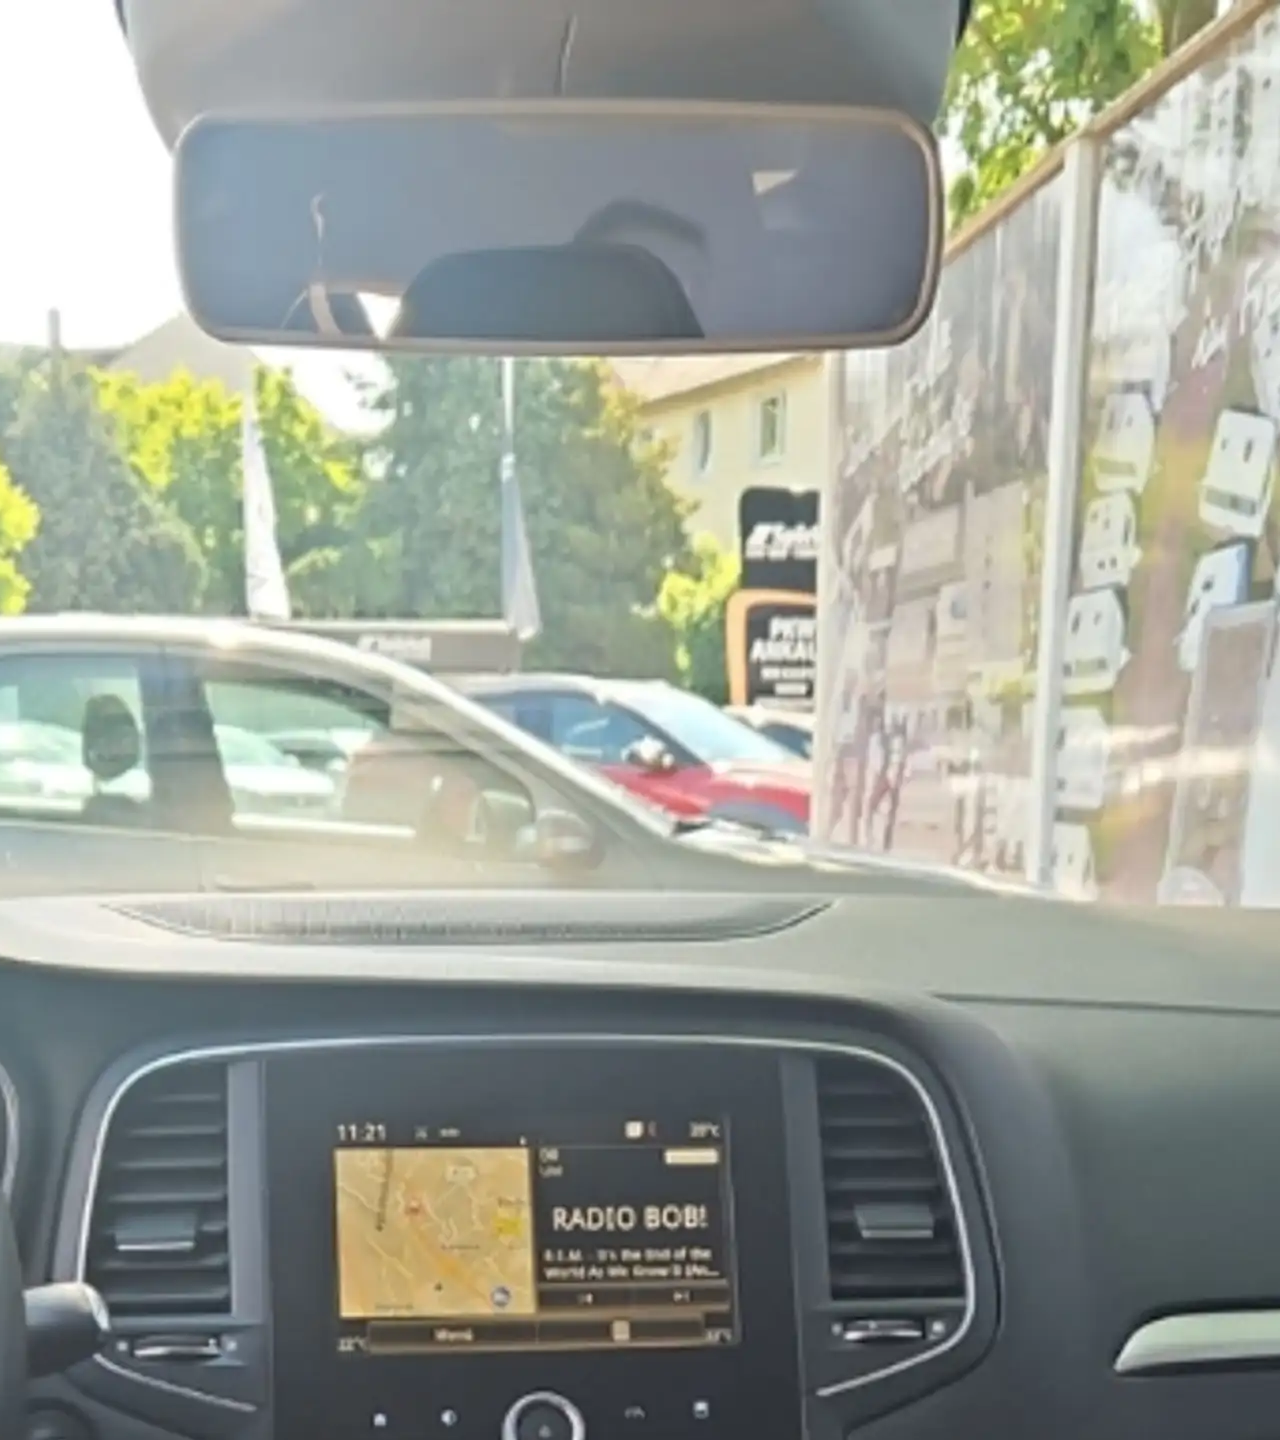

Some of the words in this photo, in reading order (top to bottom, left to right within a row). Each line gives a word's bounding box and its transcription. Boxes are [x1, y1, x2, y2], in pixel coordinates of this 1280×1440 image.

[337, 1123, 387, 1142] 11:21
[552, 1206, 637, 1232] RADIO
[643, 1203, 709, 1231] BOB!
